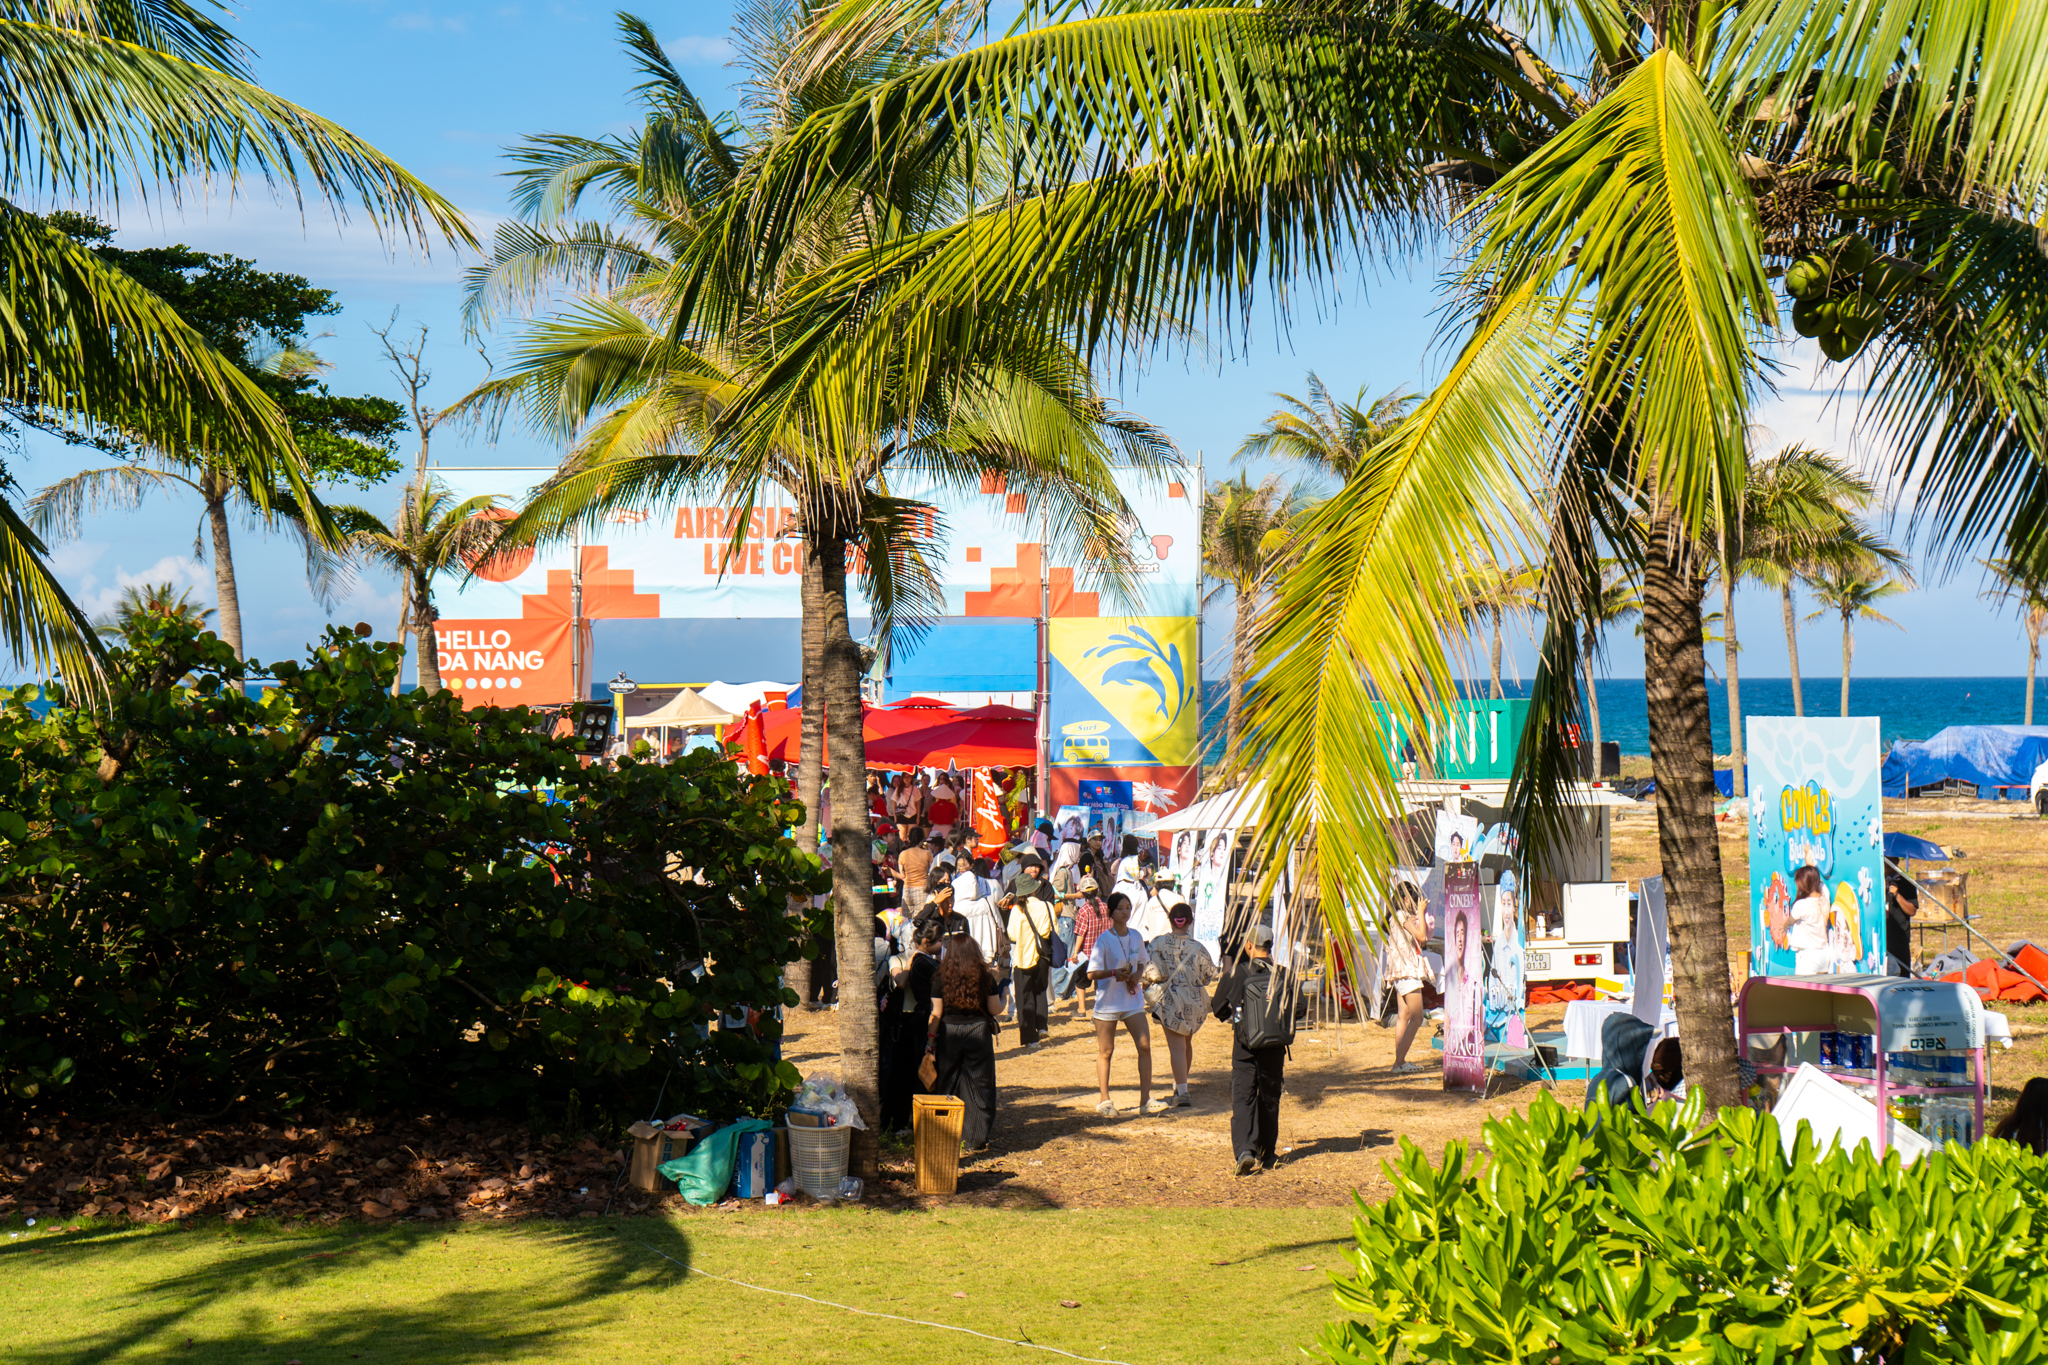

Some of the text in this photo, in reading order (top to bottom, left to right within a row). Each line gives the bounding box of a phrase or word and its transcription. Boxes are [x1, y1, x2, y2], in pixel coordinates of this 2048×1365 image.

[703, 543, 765, 575] LIVE
[435, 629, 511, 650] HELLO
[437, 650, 544, 671] DA NANG
[1077, 723, 1098, 732] Surf
[1781, 785, 1831, 836] CONGB
[1910, 1037, 1946, 1051] Reto
